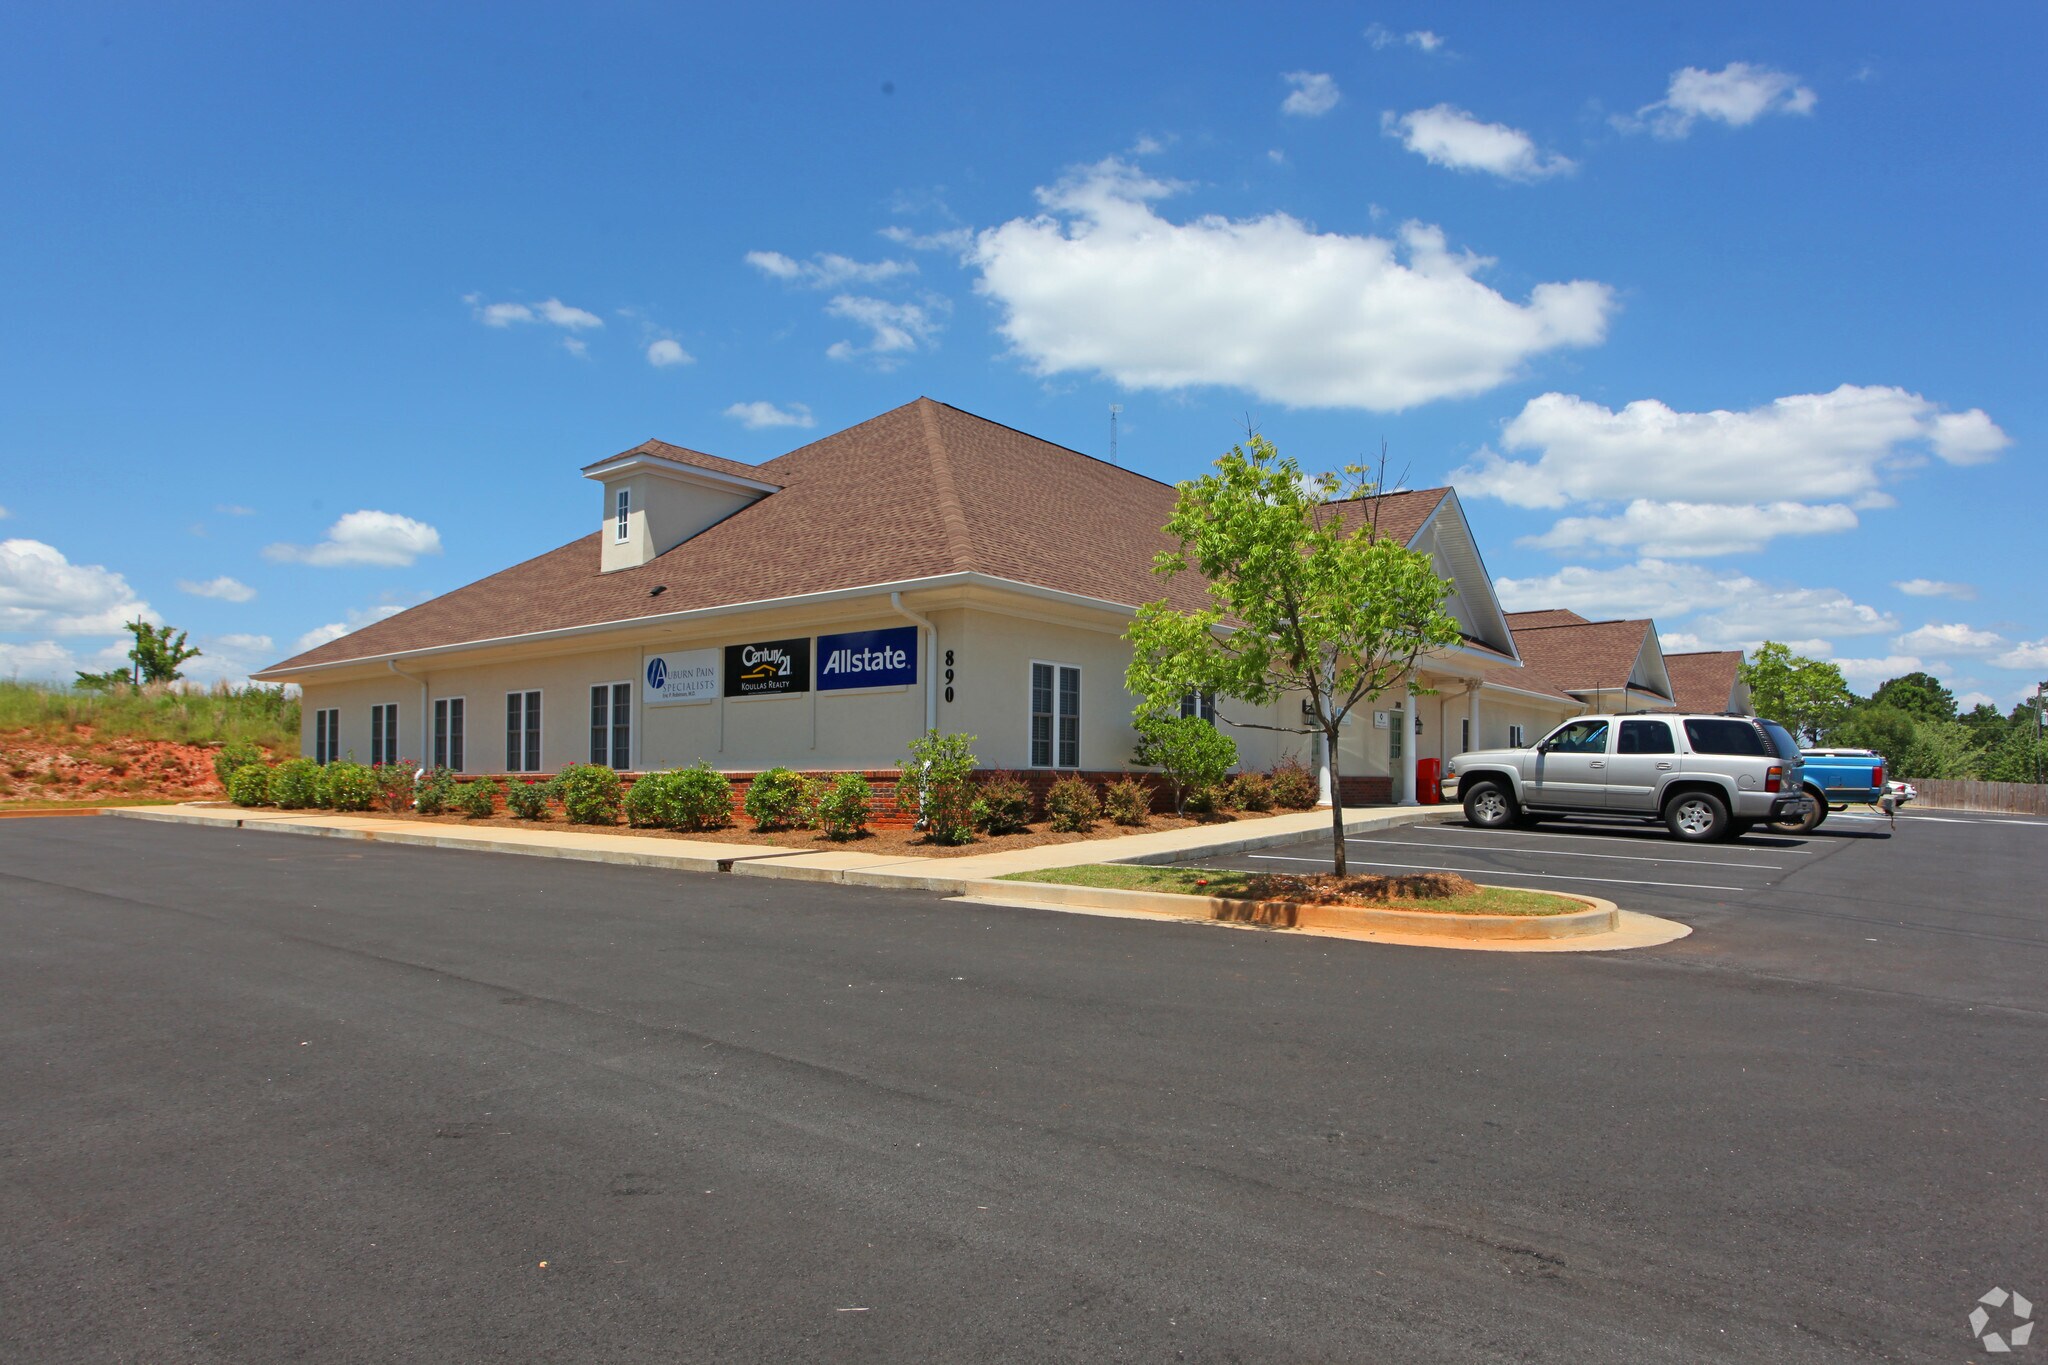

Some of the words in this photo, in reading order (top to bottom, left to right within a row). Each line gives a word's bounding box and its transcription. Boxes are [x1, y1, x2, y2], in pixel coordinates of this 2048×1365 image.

[742, 645, 783, 667] Century
[778, 655, 790, 676] 21
[823, 645, 906, 675] Allstate
[696, 666, 714, 677] PAIN
[945, 649, 954, 703] 890
[663, 679, 715, 693] SPECIALISTS
[741, 682, 767, 691] KOULLAS
[768, 680, 790, 689] REALTY
